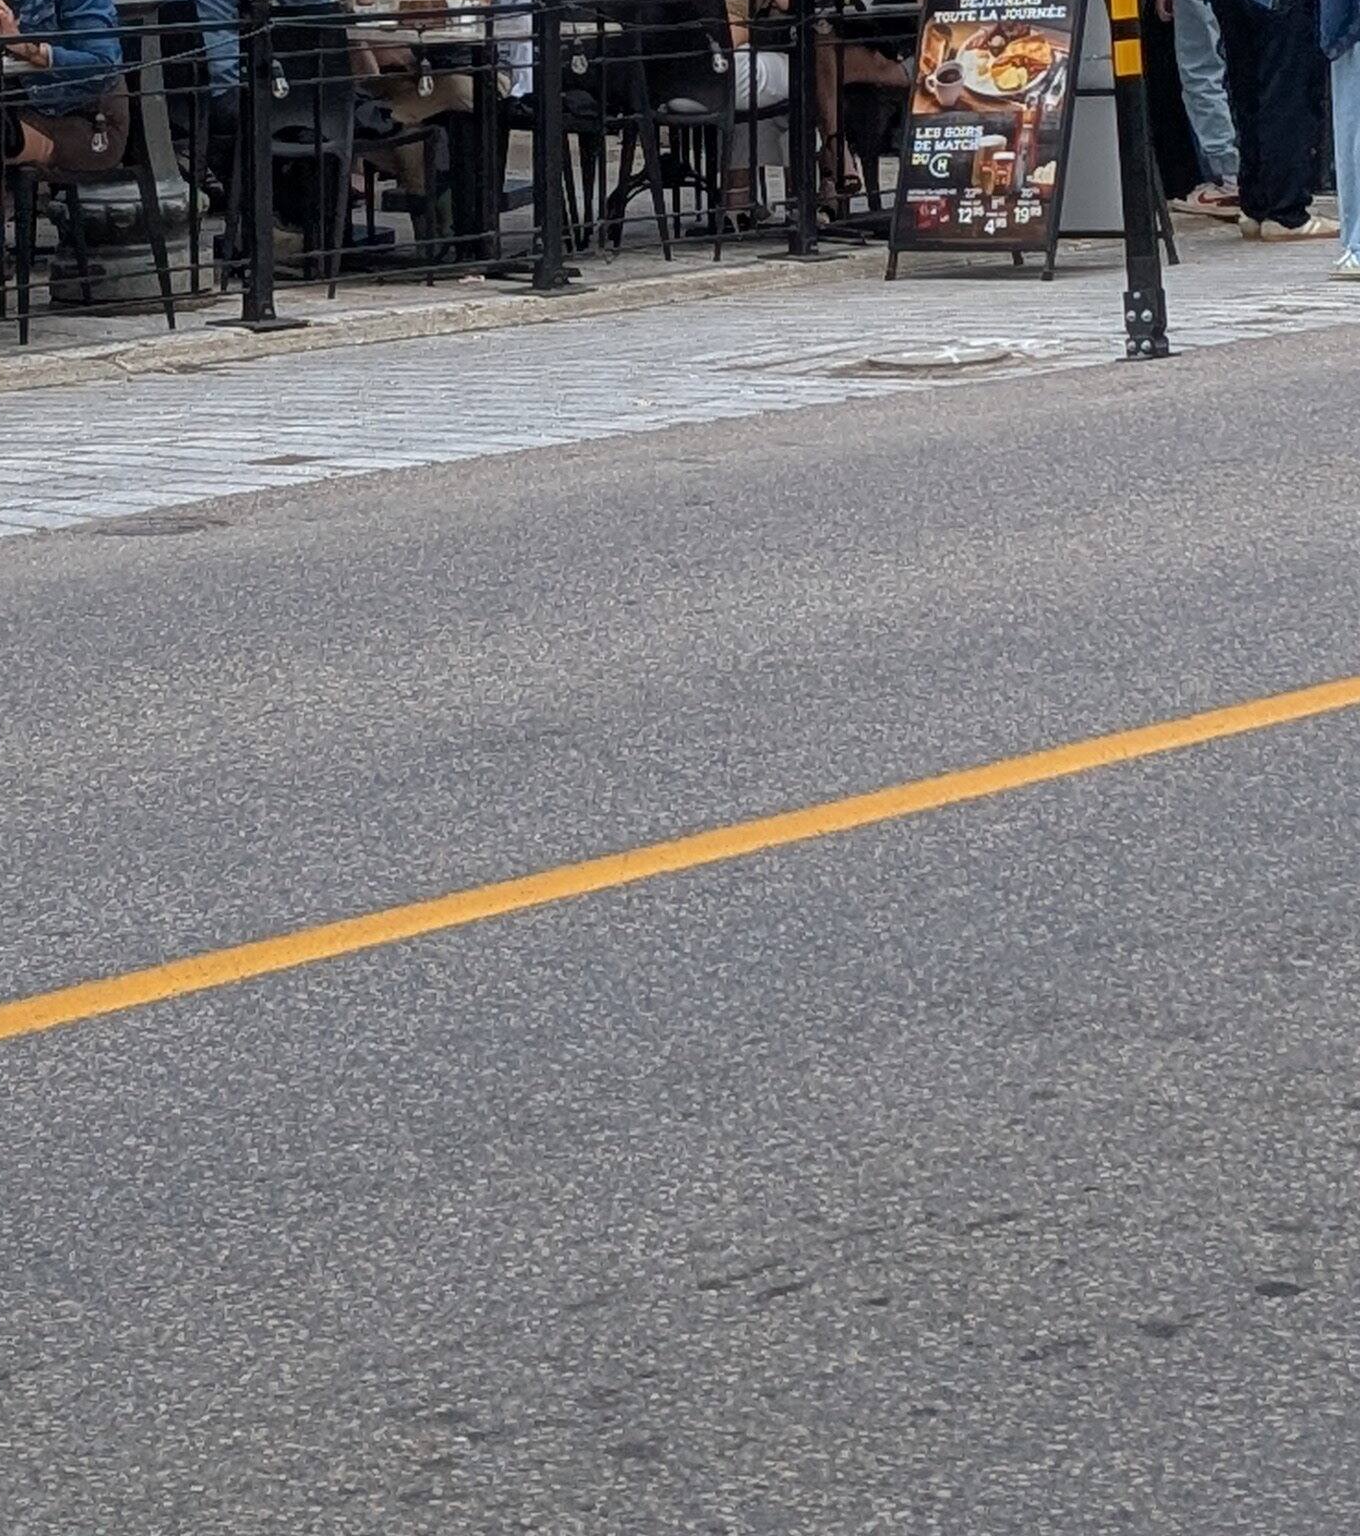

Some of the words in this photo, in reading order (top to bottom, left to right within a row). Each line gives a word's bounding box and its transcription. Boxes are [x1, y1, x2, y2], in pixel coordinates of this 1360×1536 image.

[934, 10, 978, 23] TOUTE
[979, 9, 998, 21] LA
[1001, 4, 1067, 20] JOURNÉE
[914, 140, 932, 151] DE
[934, 138, 979, 151] MATCH
